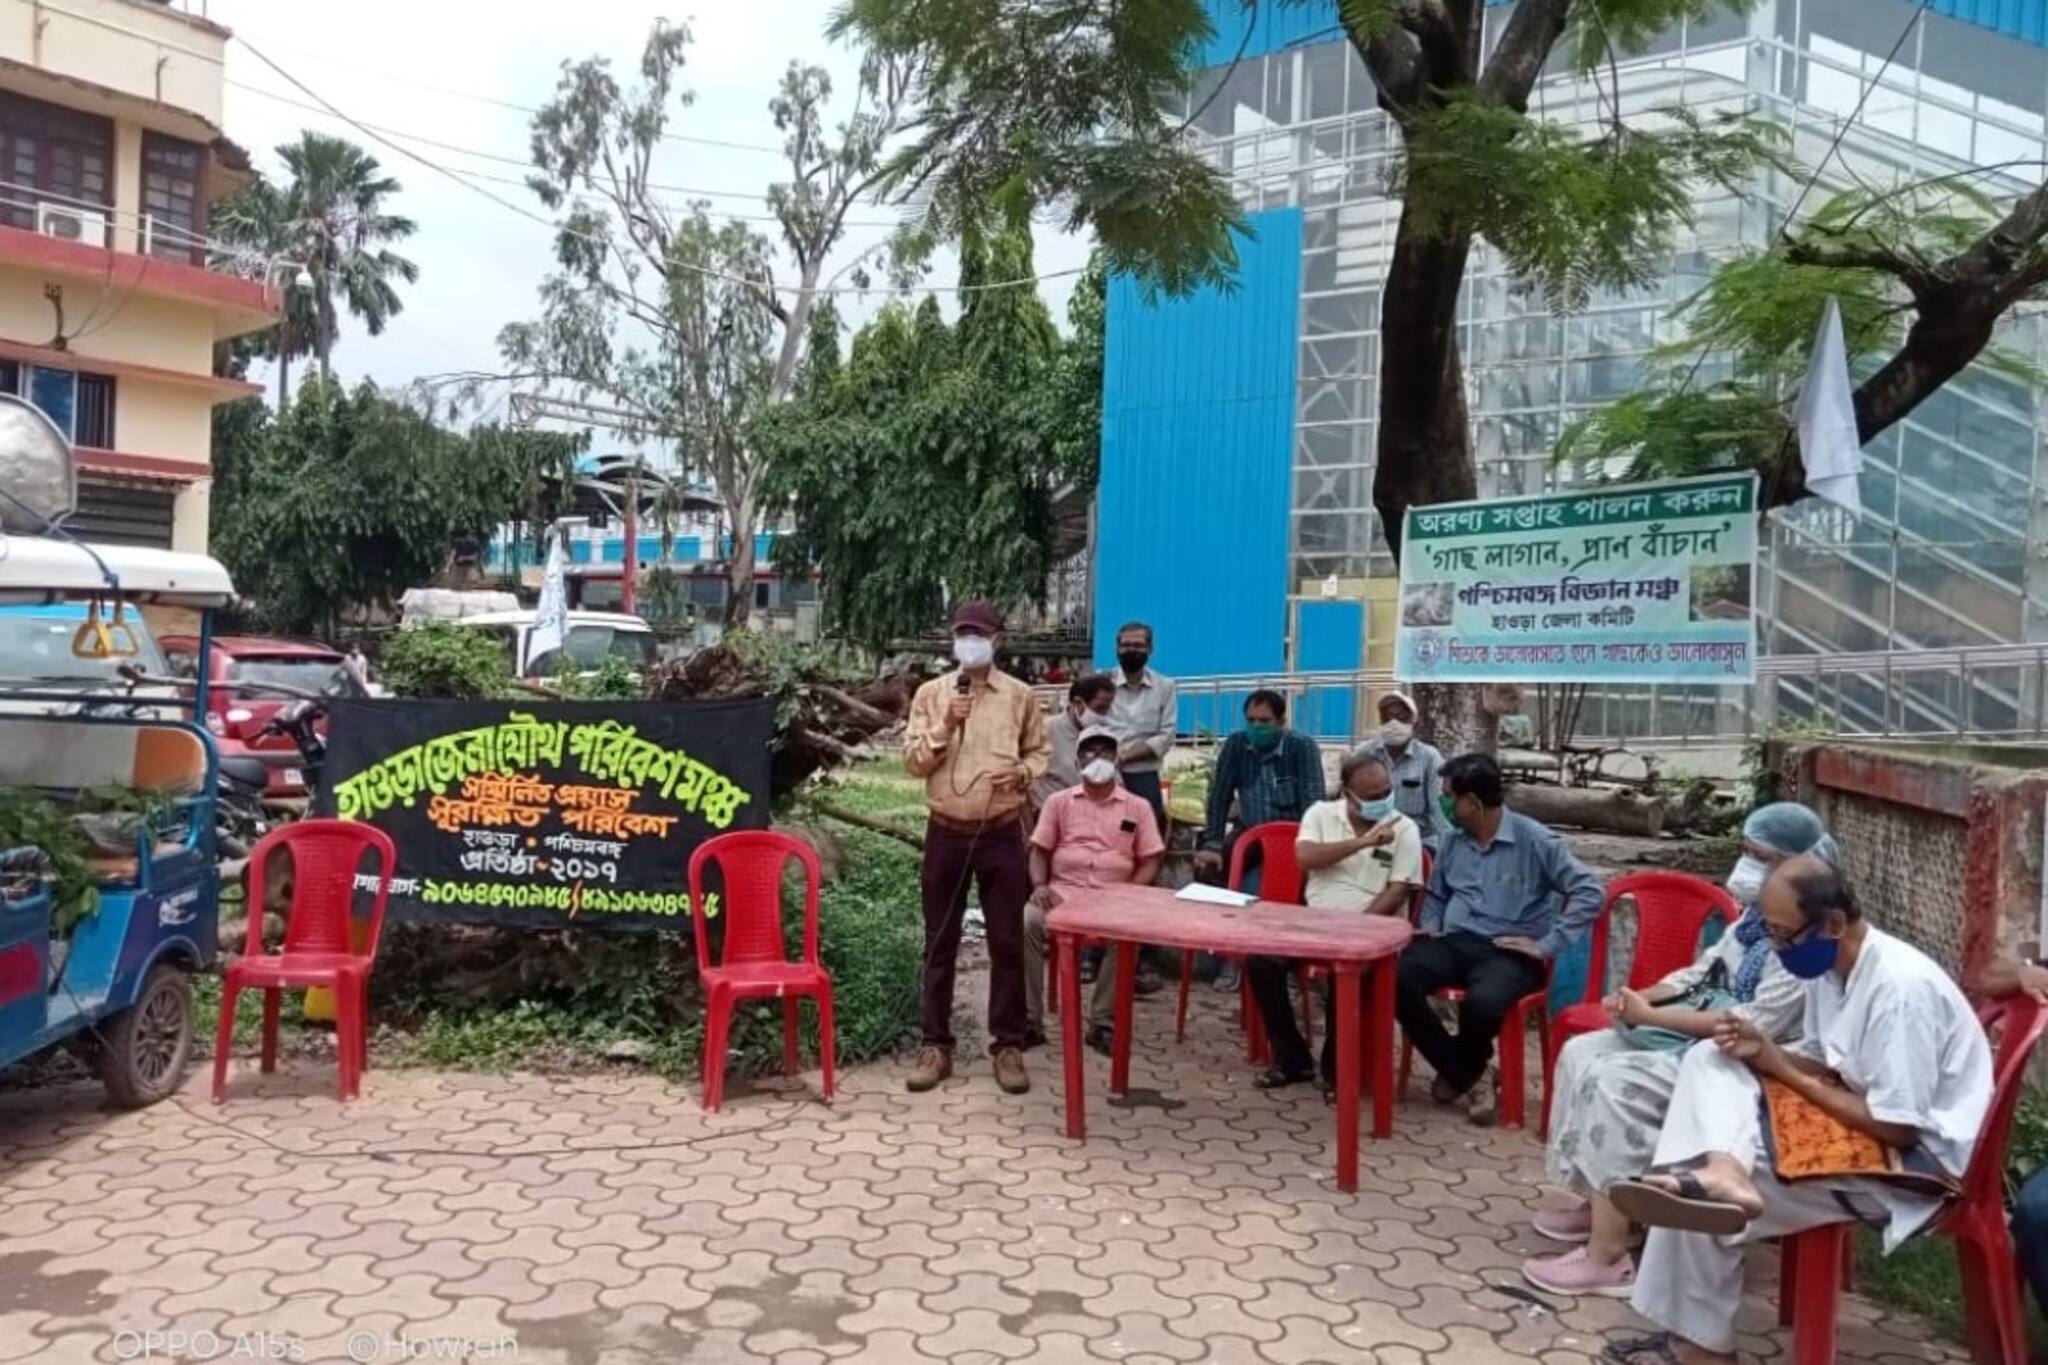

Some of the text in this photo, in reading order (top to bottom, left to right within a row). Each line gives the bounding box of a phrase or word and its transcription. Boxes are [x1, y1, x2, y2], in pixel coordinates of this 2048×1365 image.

[1417, 484, 1744, 535] অরণ্য সপ্তাহ পালন করুন
[1484, 538, 1570, 568] লাগান,
[1457, 576, 1681, 606] পশ্চিমবঙ্গ বিজ্ঞান মঞ্চ
[1491, 604, 1635, 632] হাওড়া জেলা কমিটি
[424, 724, 497, 794] জেলা
[497, 710, 569, 778] যৌথ
[569, 719, 684, 799] পরিবেশ
[675, 758, 752, 829] মঞ্চ
[561, 807, 678, 838] পরিবেশ
